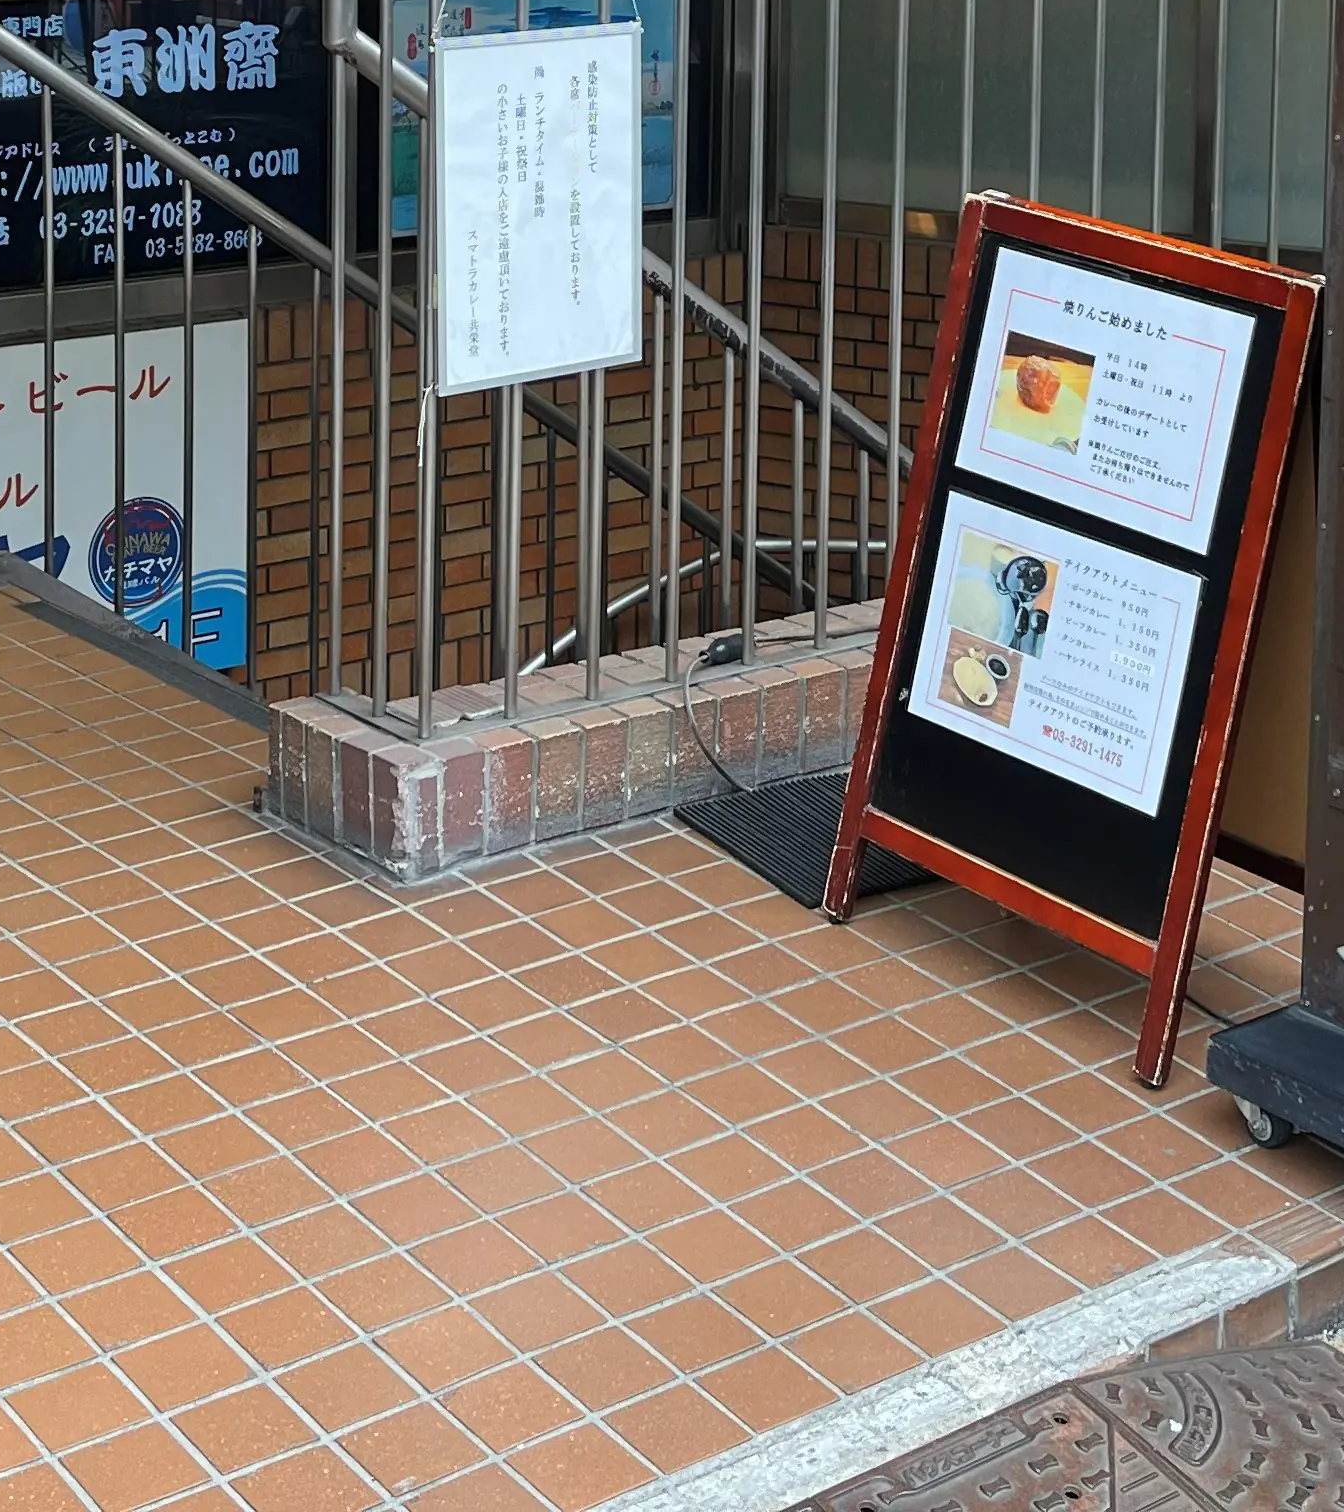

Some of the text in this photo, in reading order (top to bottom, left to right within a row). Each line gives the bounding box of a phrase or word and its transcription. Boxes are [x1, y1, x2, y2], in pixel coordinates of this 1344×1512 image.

[587, 59, 598, 174] 感染防止対策として
[94, 243, 125, 264] FA
[467, 230, 480, 357] スマトラカレー共栄堂
[1063, 298, 1168, 341] 焼りんご始めました
[1064, 558, 1158, 597] テイクアウトメニュー
[1052, 729, 1124, 768] 03-3291-1475
